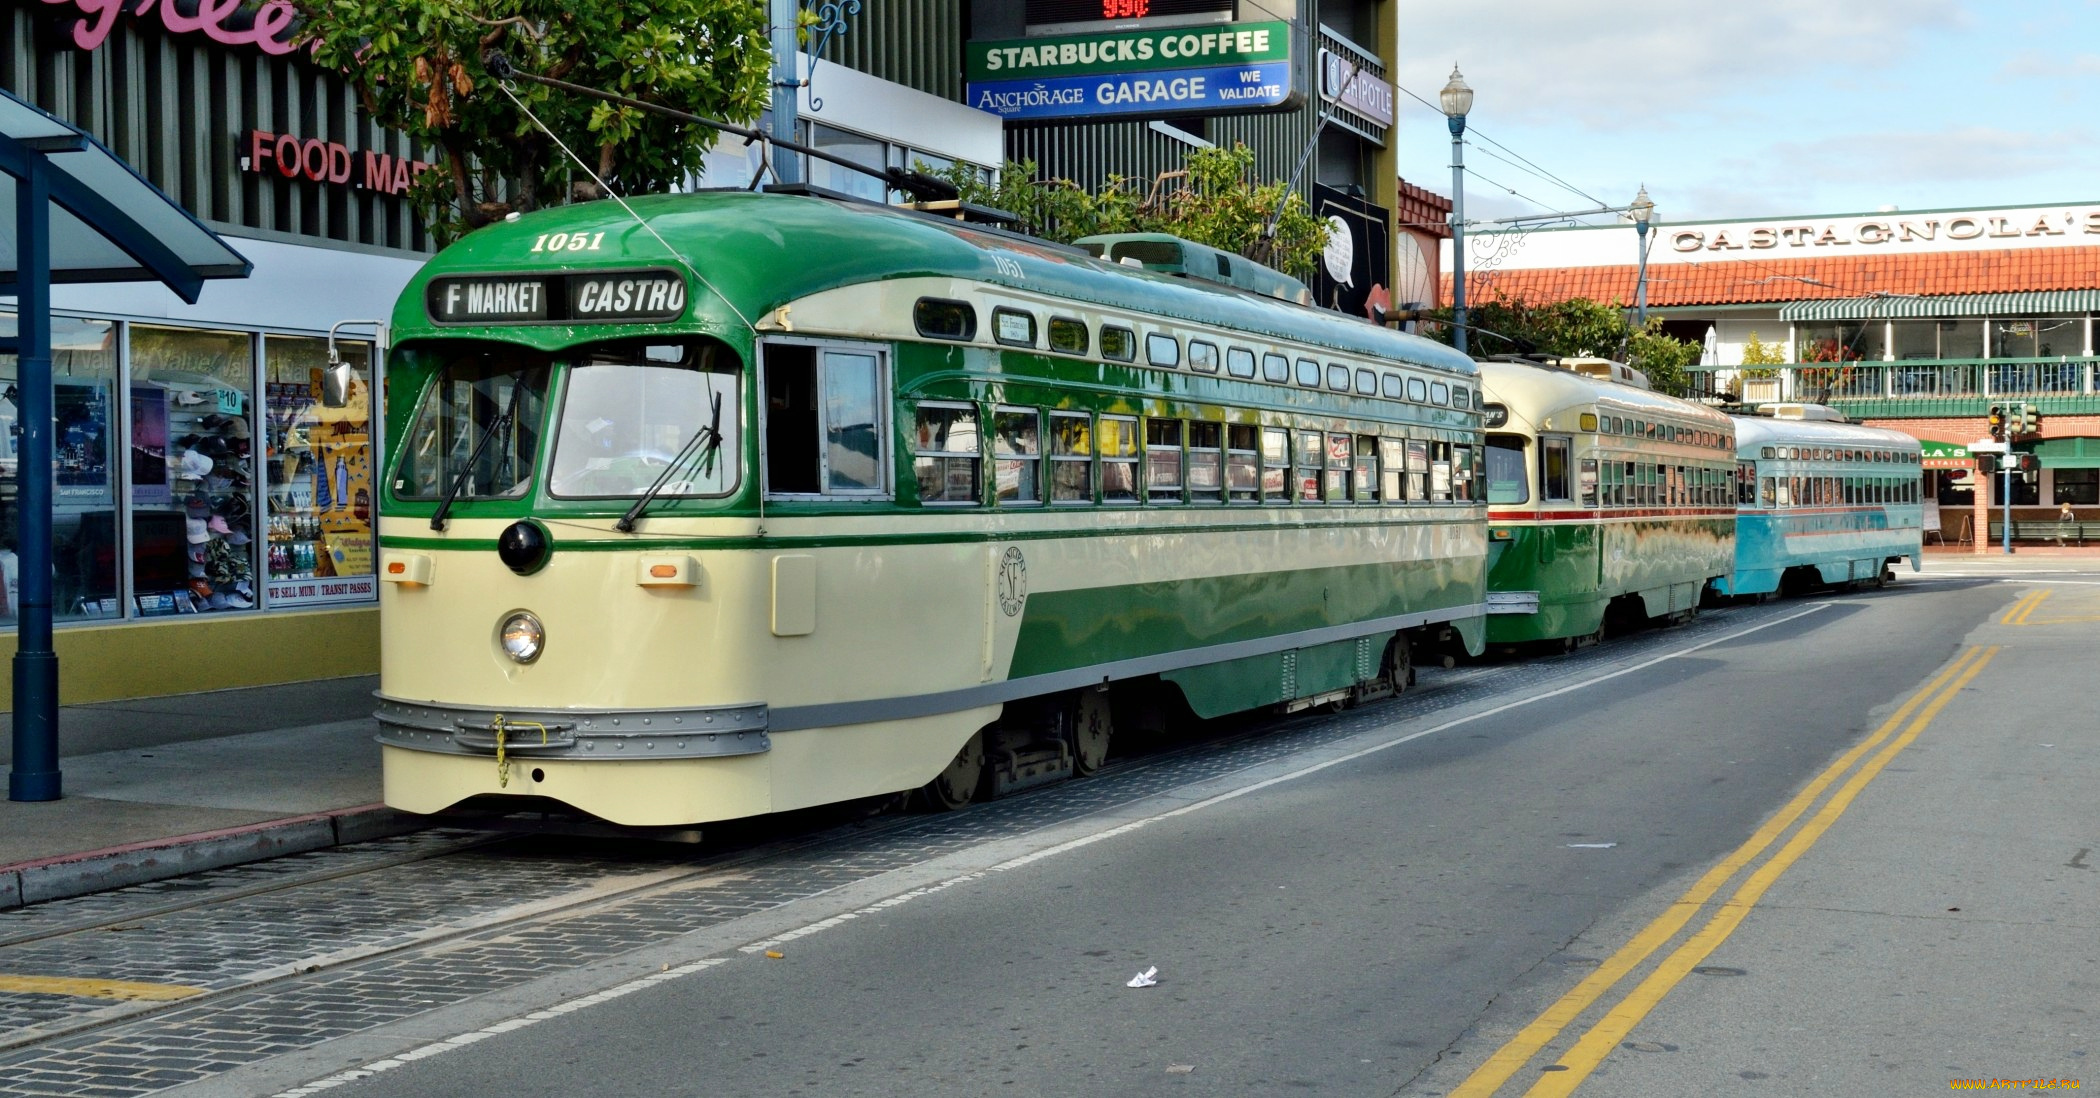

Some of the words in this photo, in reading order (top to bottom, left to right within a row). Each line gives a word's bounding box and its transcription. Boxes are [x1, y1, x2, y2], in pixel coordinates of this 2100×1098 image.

[986, 38, 1154, 70] STARBUCKS
[1159, 30, 1270, 58] COFFEE
[1240, 70, 1261, 83] WE
[977, 88, 1084, 109] ANCHORAGE
[1096, 77, 1206, 105] GARAGE
[1219, 85, 1281, 101] VALIDATE
[1343, 70, 1392, 115] CHIPOTLE
[998, 105, 1022, 114] Square
[252, 130, 351, 184] FOOD
[366, 150, 440, 195] MAR
[531, 232, 605, 252] 1051
[991, 255, 1025, 279] 1051
[447, 285, 461, 314] F
[468, 282, 542, 314] MARKET
[579, 279, 684, 312] CASTRO
[268, 587, 279, 599] WE
[281, 586, 297, 598] SELL
[299, 585, 316, 597] MUNI
[321, 583, 348, 596] TRANSIT
[349, 582, 372, 594] PASSES
